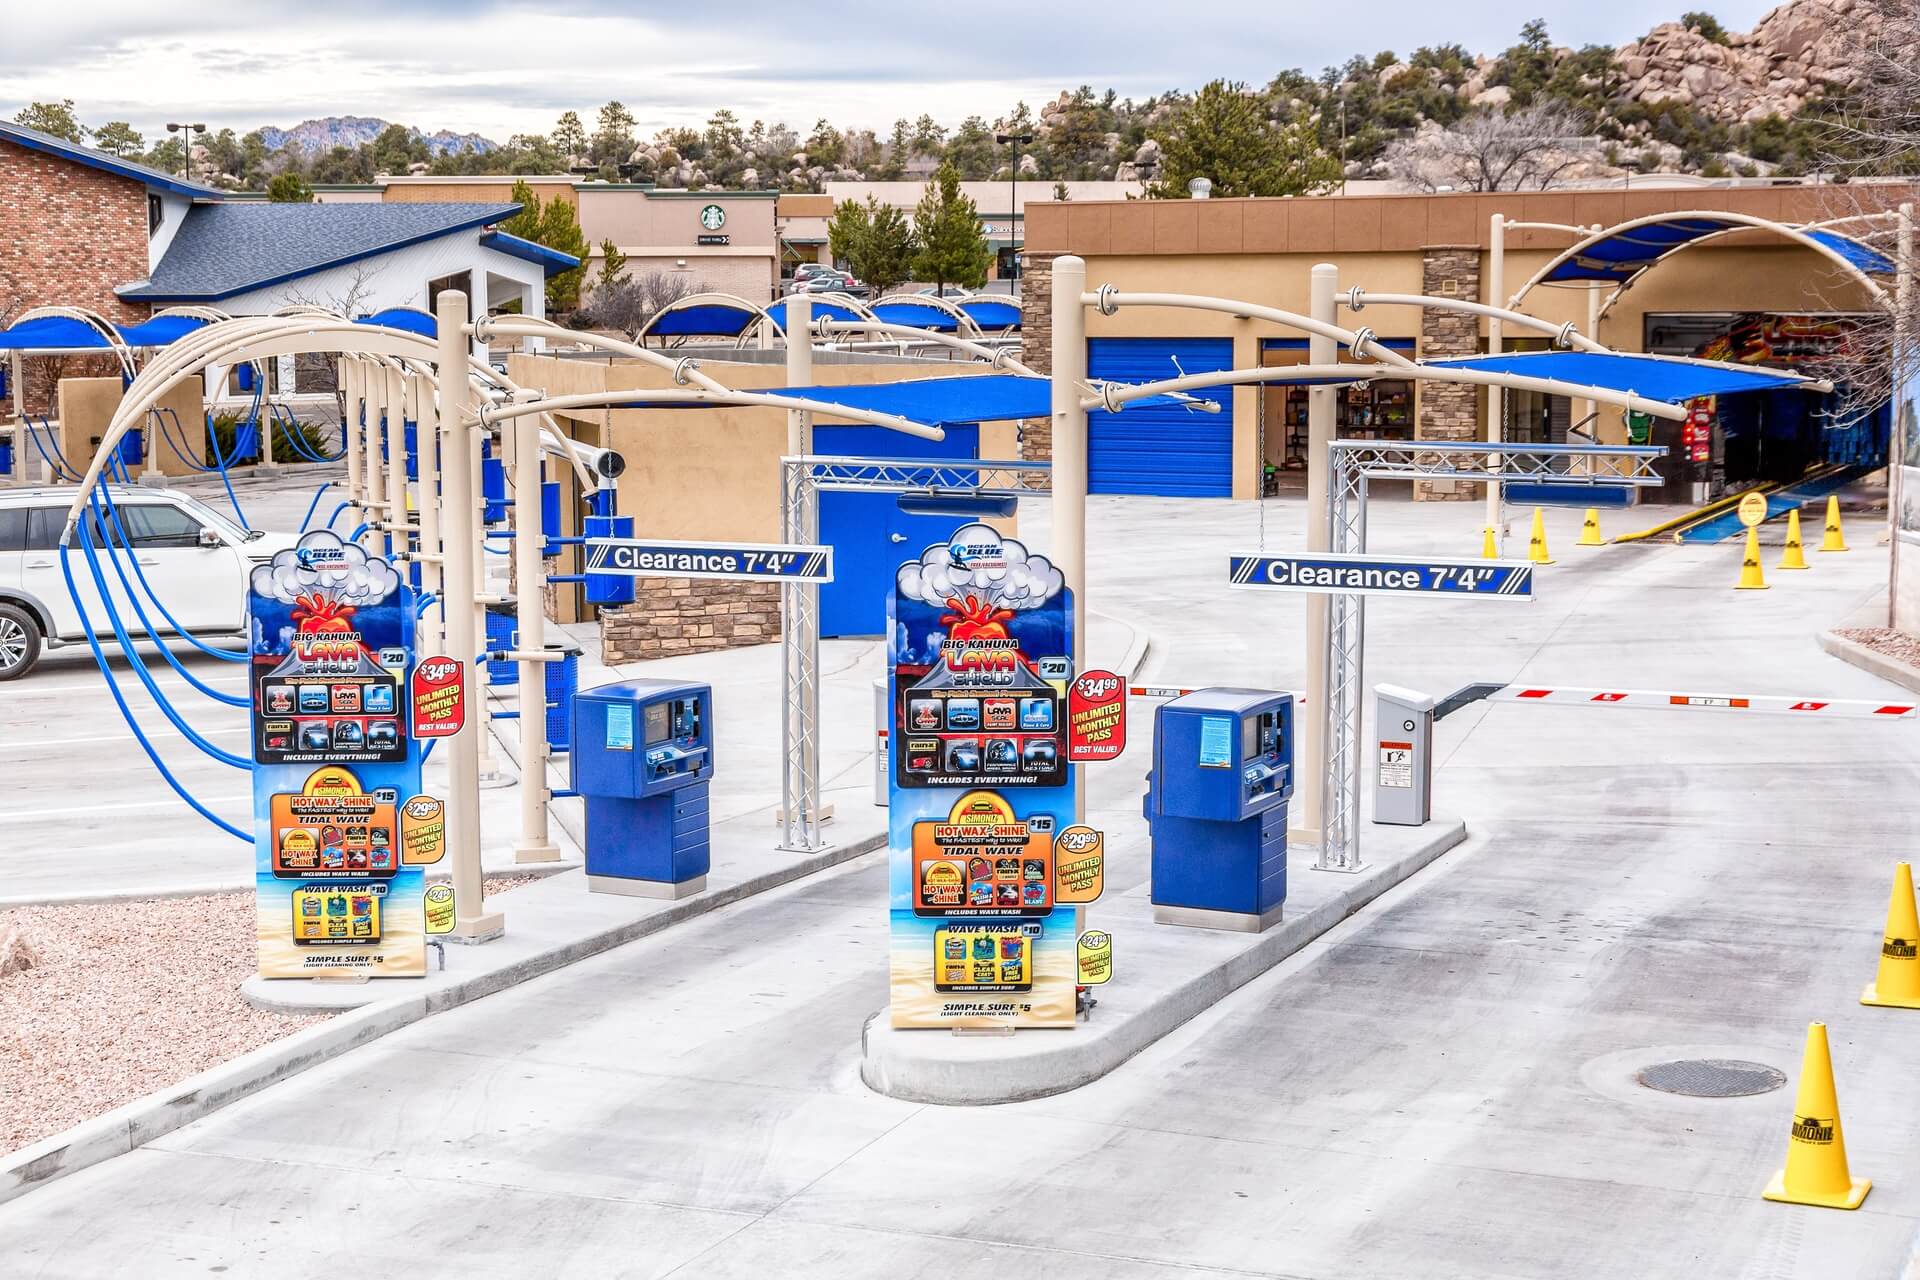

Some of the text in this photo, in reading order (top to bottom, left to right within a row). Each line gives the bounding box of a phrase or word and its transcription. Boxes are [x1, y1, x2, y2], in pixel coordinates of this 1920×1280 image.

[614, 547, 737, 572] Clearance
[1267, 560, 1420, 589] Clearance
[294, 632, 361, 641] BIG KAHUNA
[943, 639, 1018, 649] BIG KAHUNA
[297, 643, 359, 662] LAVA
[383, 653, 404, 663] $20
[946, 650, 1016, 672] LAVA
[1042, 663, 1066, 673] $20
[335, 692, 357, 700] LAVA
[416, 685, 460, 706] UNLIMITED
[420, 695, 459, 715] MONTHLY
[429, 708, 452, 721] PASS
[988, 707, 1012, 715] LAVA
[1072, 702, 1121, 725] UNLIMITED
[418, 723, 458, 731] BEST VALUE!
[1076, 715, 1120, 735] MONTHLY
[1087, 728, 1112, 743] PASS
[1074, 745, 1117, 753] BEST VALUE!
[283, 753, 381, 761] INCLUDES EVERYTHING!
[927, 776, 1037, 784] INCLUDES EVERYTHING!
[376, 791, 395, 801] $15
[292, 797, 372, 807] HOT WAX SHINE
[298, 816, 370, 824] TIDAL WAVE
[966, 814, 998, 823] SIMONIZ
[1031, 819, 1051, 830] $15
[404, 823, 442, 840] UNLIMITED
[936, 826, 1025, 836] HOT WAX SHINE
[408, 832, 442, 849] MONTHLY
[416, 843, 436, 854] PASS
[943, 847, 1024, 855] TIDAL WAVE
[282, 850, 317, 858] HOT WAX
[291, 858, 313, 866] SHINE
[1057, 857, 1100, 875] UNLIMITED
[1061, 866, 1100, 885] MONTHLY
[924, 886, 963, 894] HOT WAX
[1071, 879, 1092, 892] PASS
[934, 895, 959, 903] SHINE
[948, 925, 1018, 933] WAVE WASH
[1024, 926, 1040, 934] $10
[1088, 967, 1105, 977] PASS
[943, 1003, 1032, 1012] SIMPLE SURF $5
